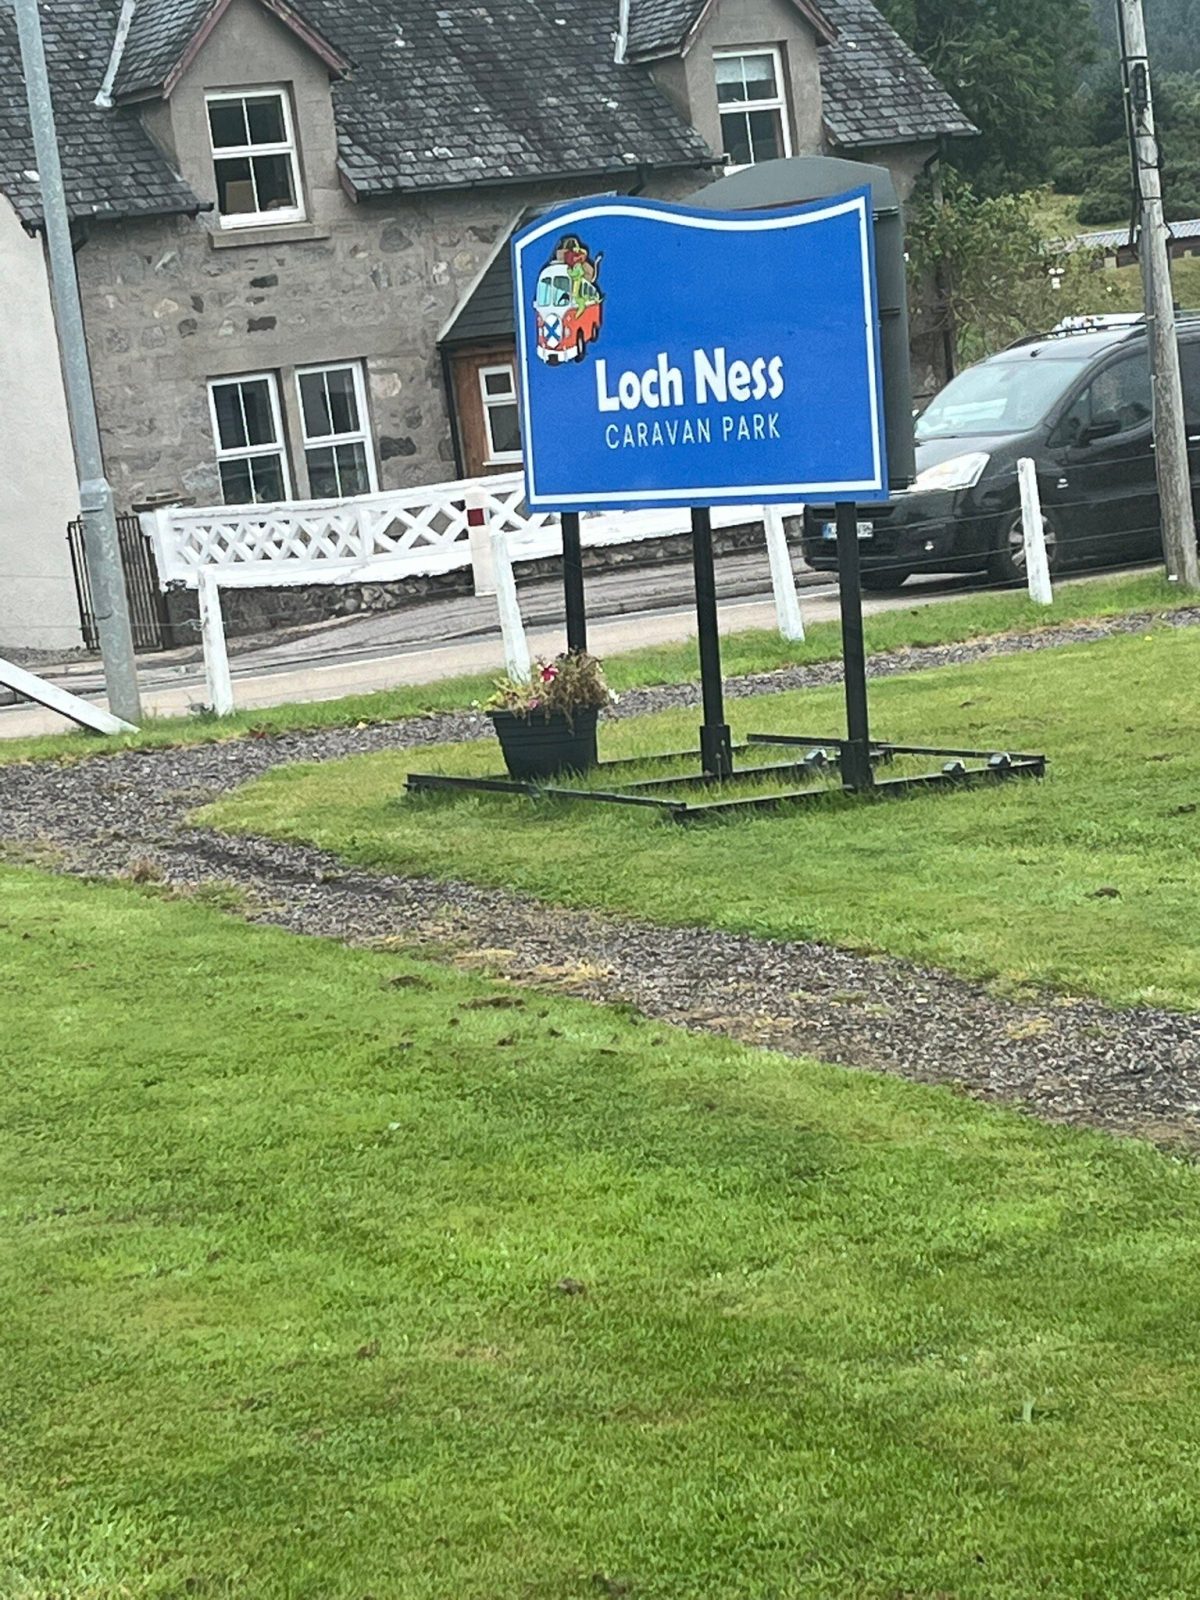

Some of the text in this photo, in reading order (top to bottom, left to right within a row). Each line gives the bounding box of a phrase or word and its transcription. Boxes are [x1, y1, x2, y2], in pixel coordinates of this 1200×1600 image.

[595, 347, 784, 412] Loch Ness
[605, 412, 781, 449] CARAVAN PARK
